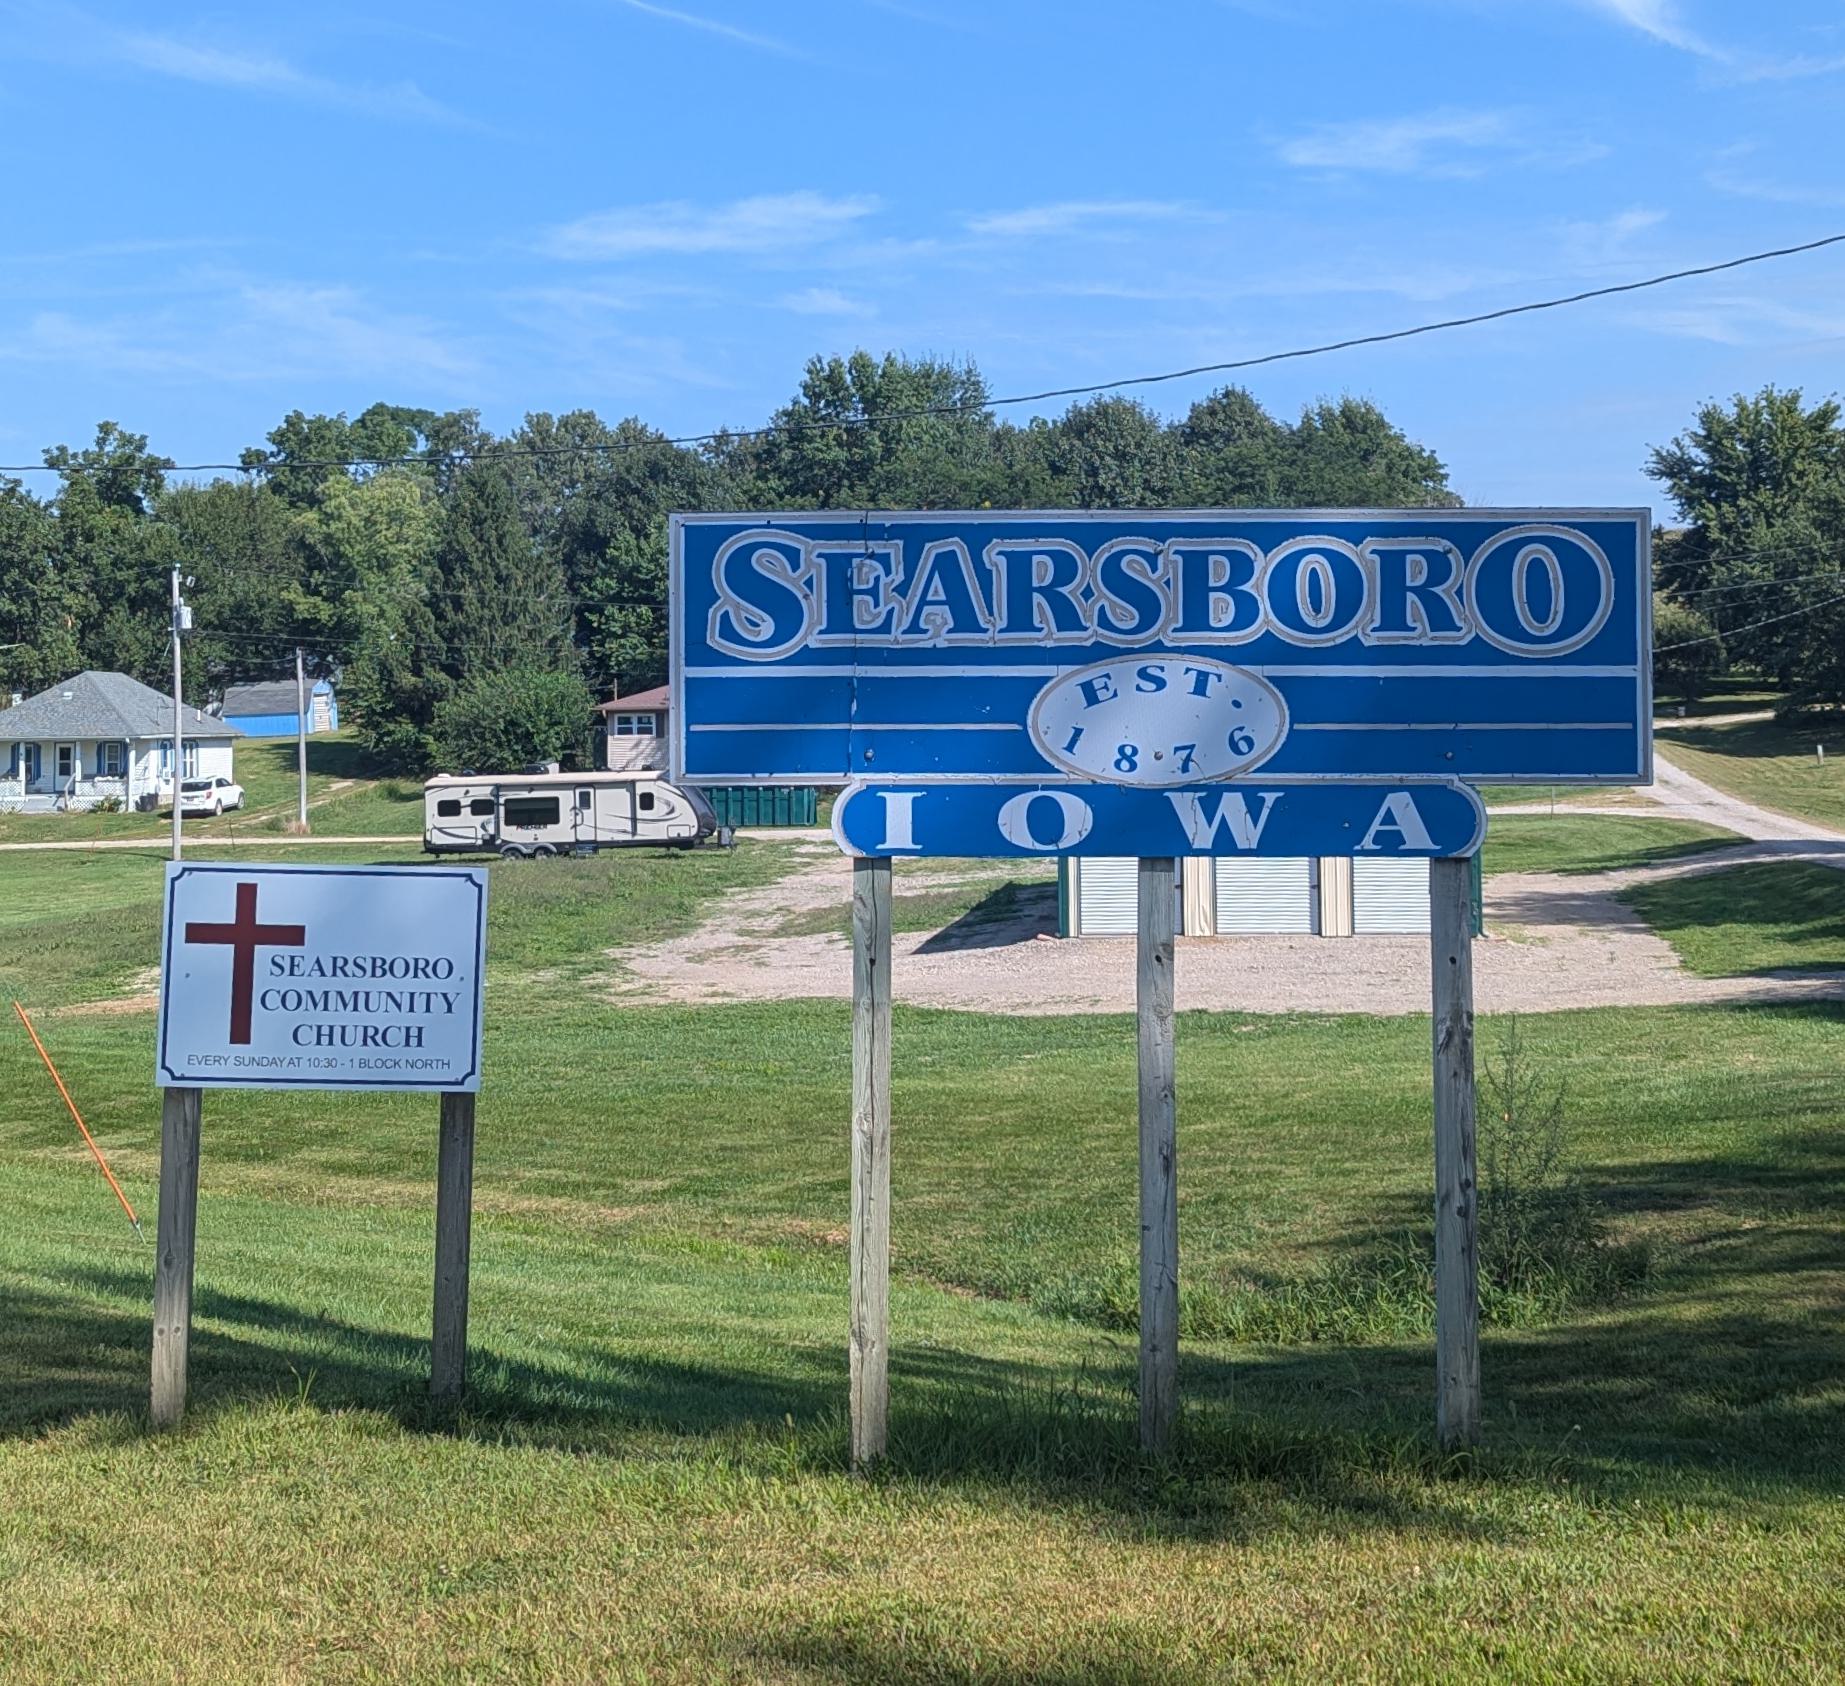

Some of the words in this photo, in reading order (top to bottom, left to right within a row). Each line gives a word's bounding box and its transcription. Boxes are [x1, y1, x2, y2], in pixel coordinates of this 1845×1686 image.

[709, 527, 1614, 660] SEARSBORO
[1075, 664, 1243, 709] EST.
[1061, 726, 1255, 774] 1876
[875, 790, 1442, 851] IOWA
[269, 954, 454, 980] SEARSBORO
[260, 988, 462, 1014] COMMUNITY
[292, 1024, 426, 1048] CHURCH
[187, 1054, 231, 1066] EVERY
[233, 1055, 287, 1068] SUNDAY
[287, 1057, 303, 1068] AT
[307, 1057, 338, 1068] 10:30
[349, 1057, 354, 1068] 1
[358, 1058, 402, 1069] BLOCK
[405, 1058, 451, 1069] NORTH
